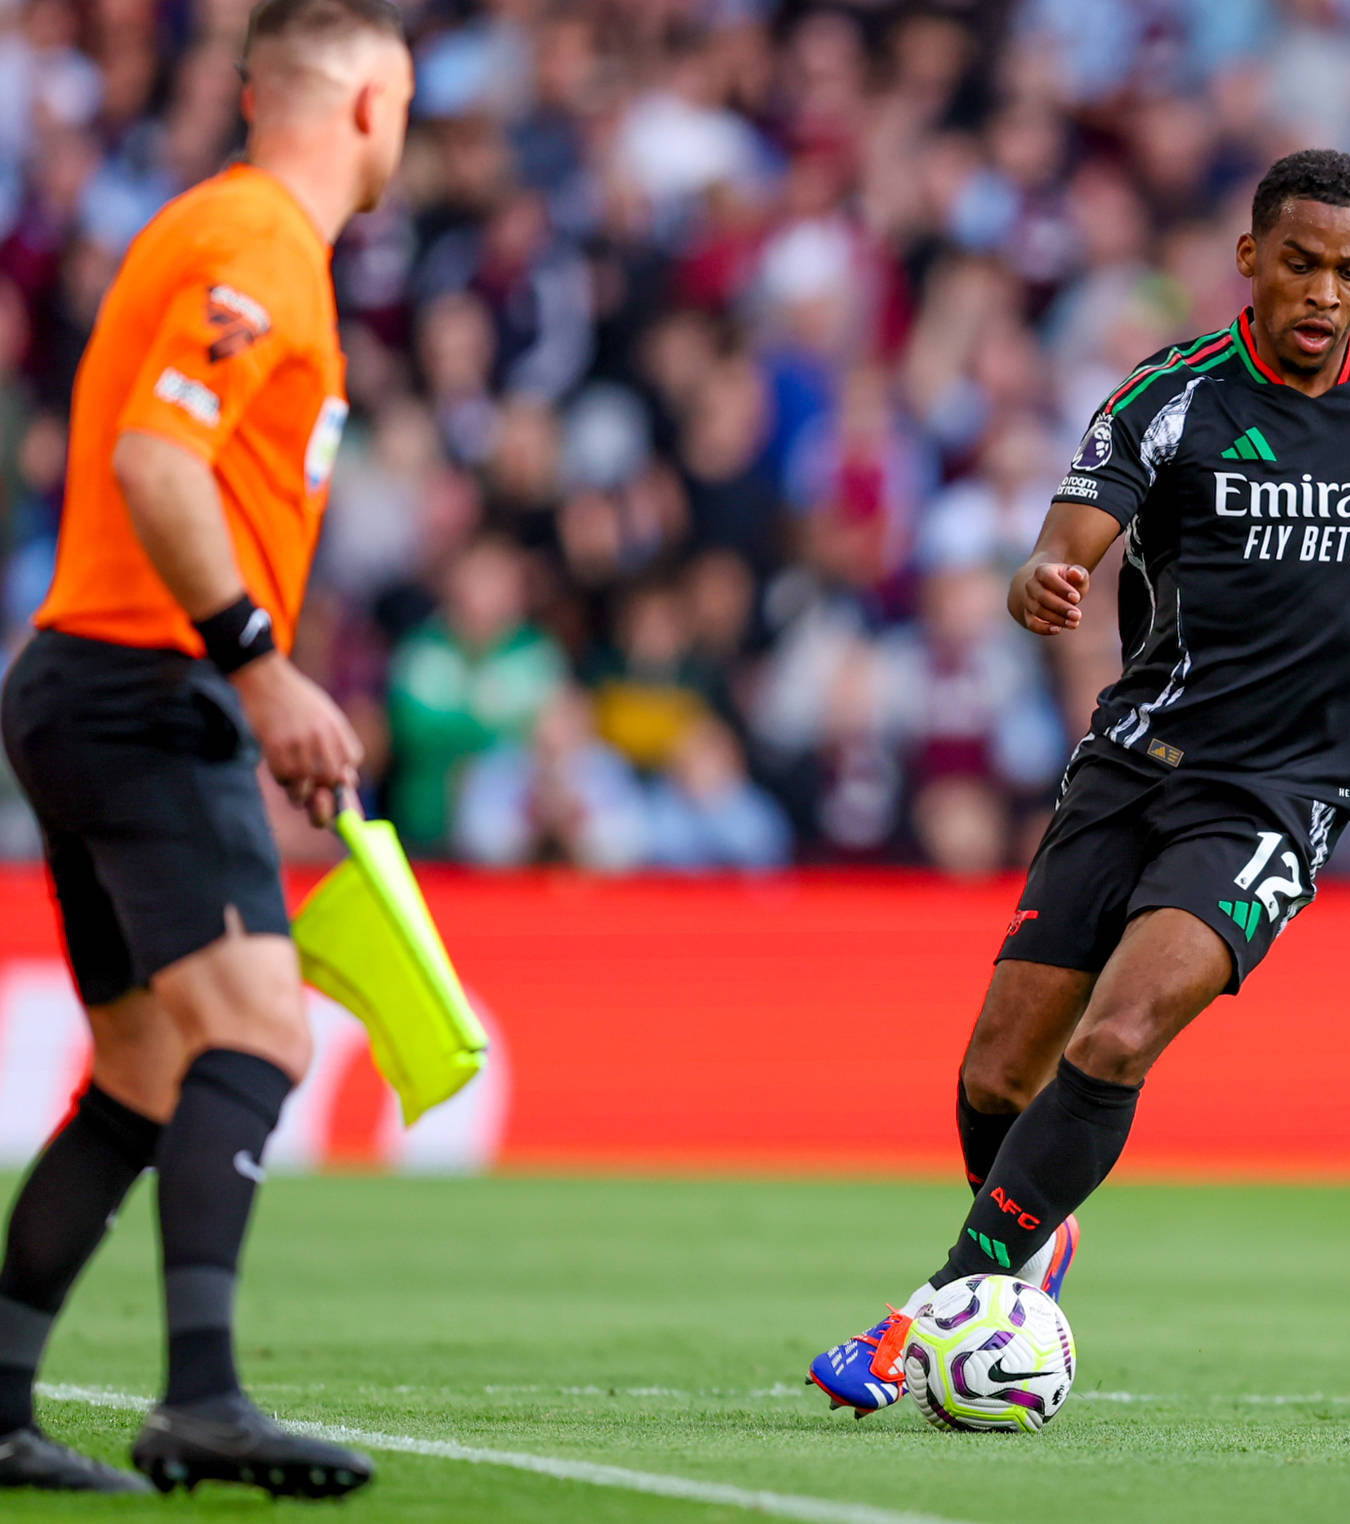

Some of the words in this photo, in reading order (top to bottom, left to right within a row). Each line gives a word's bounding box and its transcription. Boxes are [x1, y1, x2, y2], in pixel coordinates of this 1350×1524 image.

[1068, 476, 1098, 490] room
[1243, 525, 1294, 560] FLY
[1233, 831, 1303, 924] 12
[989, 1186, 1041, 1231] AFC
